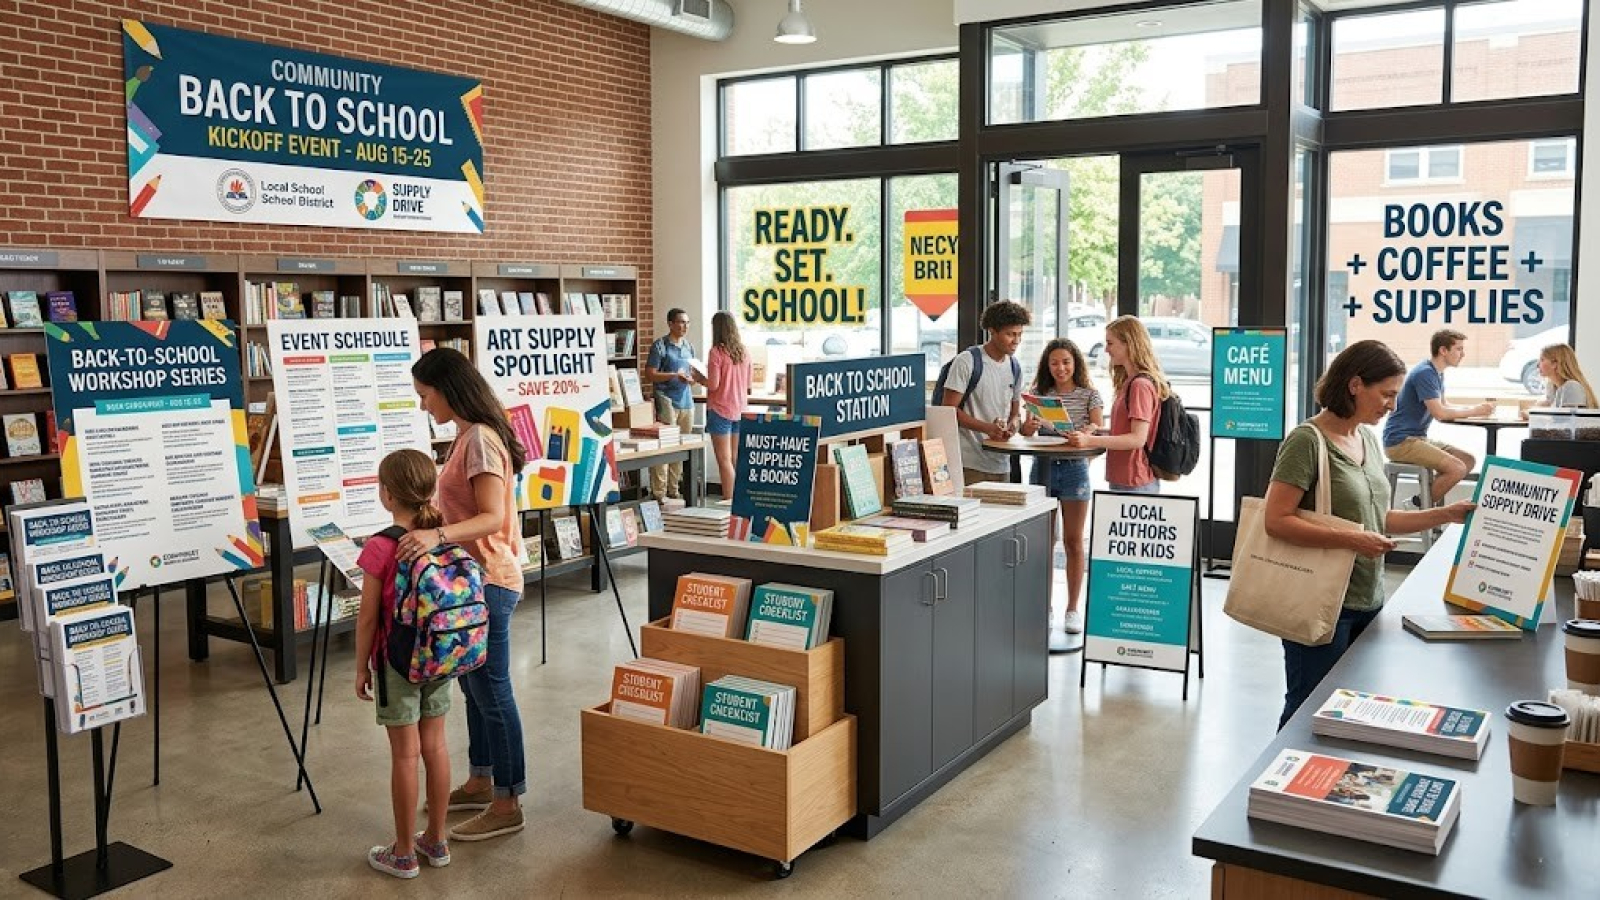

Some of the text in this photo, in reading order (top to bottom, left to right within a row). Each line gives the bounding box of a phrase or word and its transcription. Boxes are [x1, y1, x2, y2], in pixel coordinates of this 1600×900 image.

[270, 59, 382, 96] COMMUNITY
[179, 73, 454, 146] BACK TO SCHOOL
[207, 125, 284, 152] KICKOFF
[288, 133, 341, 158] EVENT
[356, 142, 389, 164] AUG
[391, 145, 433, 168] 15-25
[261, 180, 325, 195] Local School
[392, 182, 432, 199] SUPPLY
[298, 196, 335, 209] District
[392, 199, 424, 213] DRIVE
[755, 207, 853, 245] READY.
[1383, 200, 1504, 239] BOOKS
[910, 235, 959, 256] NECY
[774, 248, 832, 283] SET.
[1377, 245, 1510, 282] COFFEE
[743, 288, 866, 323] SCHOOL!
[1372, 288, 1545, 325] SUPPLIES
[281, 330, 410, 351] EVENT SCHEDULE
[487, 326, 596, 351] ART SUPPLY
[71, 345, 221, 369] BACK-TO-SCHOOL
[493, 352, 596, 377] SPOTLIGHT
[1226, 342, 1270, 364] CAFÉ
[68, 366, 227, 393] WORKSHOP SERIES
[518, 381, 550, 396] SAVE
[553, 379, 580, 395] 20%
[805, 365, 916, 400] BACK TO SCHOOL
[1223, 367, 1273, 386] MENU
[836, 394, 890, 424] STATION
[745, 433, 811, 453] MUST-HAVE
[748, 450, 803, 470] SUPPLIES
[748, 468, 799, 486] & BOOKS
[1490, 477, 1560, 503] COMMUNITY
[1120, 503, 1167, 522] LOCAL
[1523, 504, 1559, 524] DRIVE
[1108, 521, 1178, 541] AUTHORS
[1108, 540, 1175, 560] FOR KIDS
